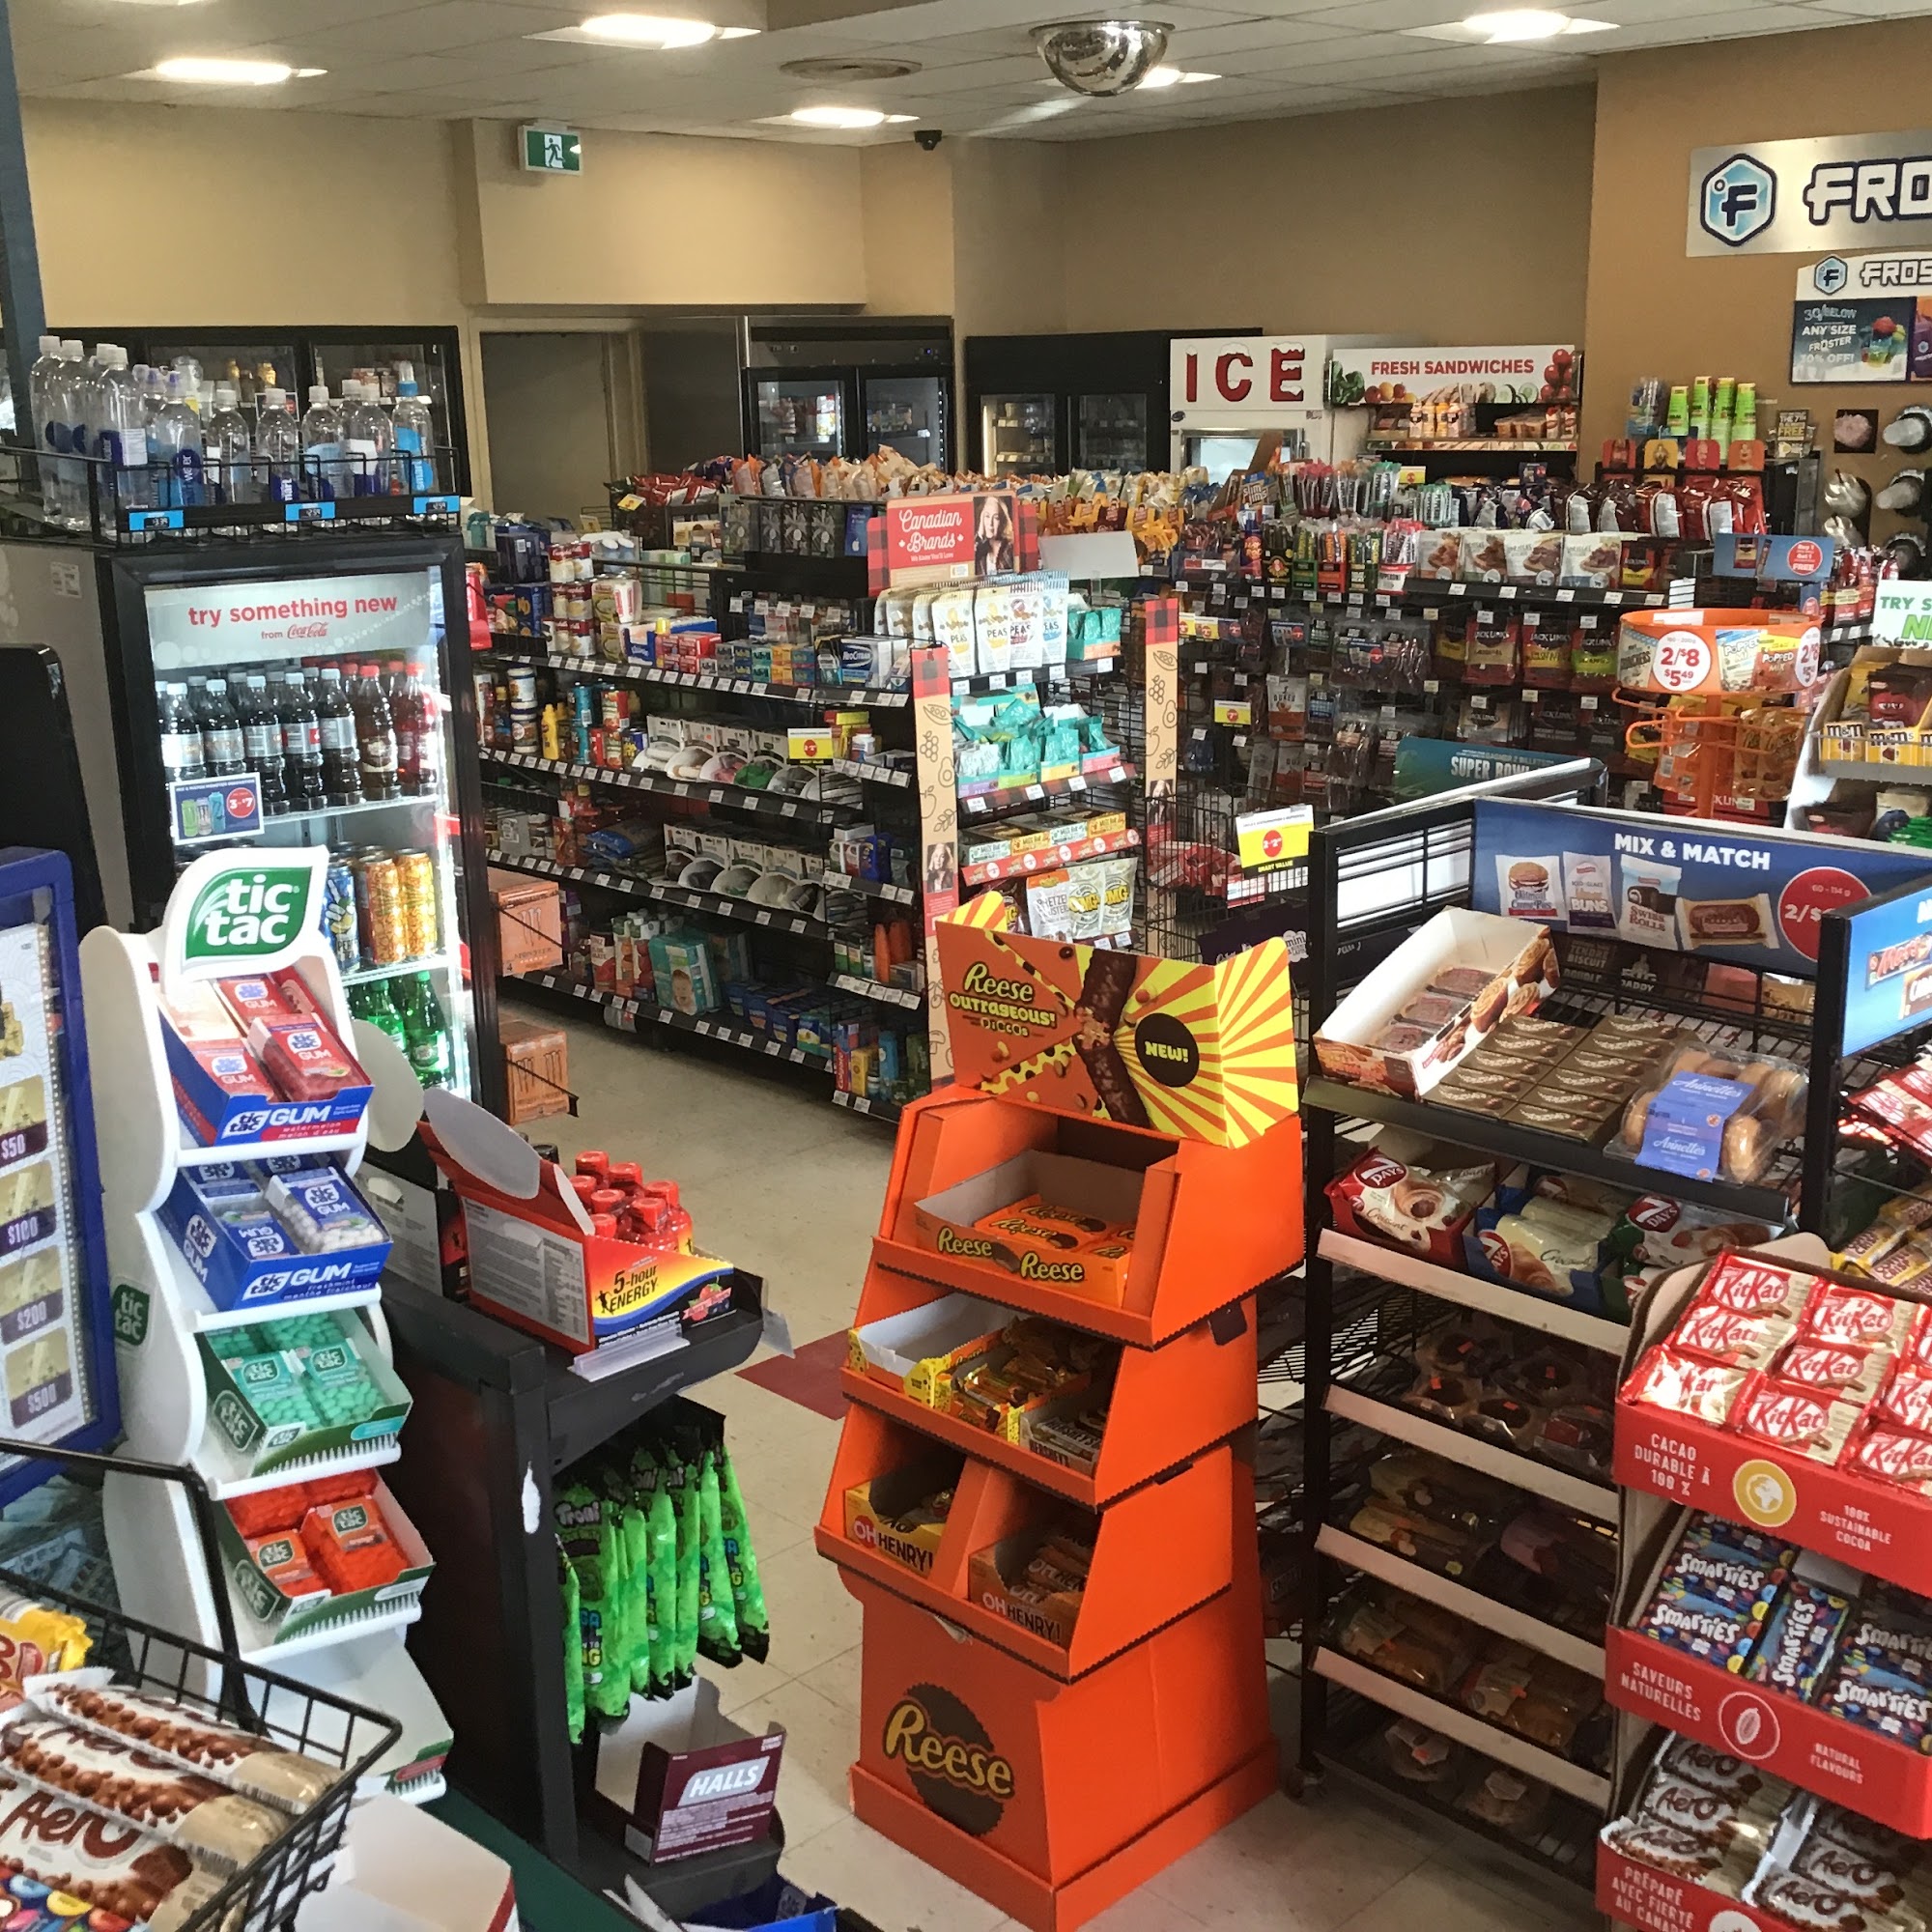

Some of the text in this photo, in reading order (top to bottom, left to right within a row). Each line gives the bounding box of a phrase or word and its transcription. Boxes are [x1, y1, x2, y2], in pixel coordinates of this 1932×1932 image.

[1802, 326, 1857, 335] ANY SIZE
[1809, 336, 1852, 352] FROSTER
[1185, 342, 1305, 402] ICE
[1371, 359, 1534, 376] FRESH SANDWICHES
[898, 509, 962, 532] Canadian
[907, 531, 955, 553] Brands
[188, 594, 398, 628] try something new
[1880, 596, 1915, 610] TRY
[261, 629, 283, 639] from
[951, 634, 967, 643] PEAS
[987, 628, 1008, 638] PEAS
[1661, 647, 1700, 667] 2/$8
[1451, 756, 1491, 780] SUPER
[229, 799, 238, 810] 3
[1614, 833, 1771, 869] MIX & MATCH
[224, 874, 293, 915] tic
[1571, 897, 1608, 912] BUNS
[205, 911, 289, 946] tac
[1630, 916, 1665, 932] ROLLS
[1286, 936, 1306, 947] mini
[1567, 953, 1607, 968] BISCUIT
[963, 963, 1034, 1002] Reese
[296, 1033, 316, 1041] tic
[298, 1050, 331, 1061] GUM
[1145, 1041, 1189, 1063] NEW!
[240, 1113, 263, 1123] tic
[270, 1105, 331, 1125] GUM
[230, 1122, 260, 1132] tac
[1, 1134, 25, 1158] $50
[1361, 1157, 1395, 1179] 7
[1371, 1165, 1405, 1185] DAYS
[309, 1194, 336, 1205] tac
[311, 1187, 331, 1196] tic
[317, 1202, 351, 1214] GUM
[1635, 1196, 1671, 1222] 7
[1647, 1208, 1677, 1228] DAYS
[8, 1217, 39, 1245] $100
[938, 1227, 992, 1256] Reese
[1020, 1251, 1084, 1282] Reese
[1492, 1248, 1509, 1266] AYS
[260, 1273, 283, 1286] tic
[291, 1263, 352, 1286] GUM
[613, 1265, 659, 1293] 5-hour
[250, 1284, 279, 1294] tac
[610, 1278, 659, 1312] ENERGY
[1719, 1270, 1781, 1309] KitKat
[17, 1302, 47, 1330] $200
[122, 1292, 143, 1318] tic
[115, 1312, 141, 1342] tac
[1821, 1300, 1888, 1335] KitKat
[317, 1358, 343, 1368] tac
[320, 1350, 340, 1361] tic
[1789, 1350, 1855, 1381] KitKat
[248, 1371, 274, 1380] tac
[253, 1361, 272, 1373] tic
[27, 1384, 57, 1413] $500
[1757, 1397, 1824, 1435] KitKat
[1651, 1434, 1696, 1460] CACAO
[1634, 1445, 1693, 1479] DURABLE
[1651, 1469, 1675, 1490] 100
[337, 1517, 364, 1530] tac
[342, 1508, 361, 1520] tic
[1843, 1505, 1870, 1521] 100%
[1820, 1511, 1891, 1545] SUSTAINABLE
[268, 1544, 288, 1554] tic
[853, 1520, 933, 1572] OH HENRY!
[1835, 1530, 1871, 1552] COCOA
[263, 1550, 293, 1563] tac
[982, 1593, 1007, 1616] OH
[1008, 1605, 1061, 1644] HENRY!
[1633, 1662, 1693, 1700] SAVEURS
[1621, 1674, 1702, 1722] NATURELLES
[886, 1704, 1011, 1794] Reese
[1815, 1743, 1861, 1770] NATURAL
[1810, 1754, 1863, 1784] FLAVOURS
[689, 1766, 758, 1798] HALLS
[1625, 1866, 1683, 1903] PRÉPARÉ
[1612, 1879, 1694, 1928] AVEC FIERTÉ
[1616, 1897, 1631, 1915] AU
